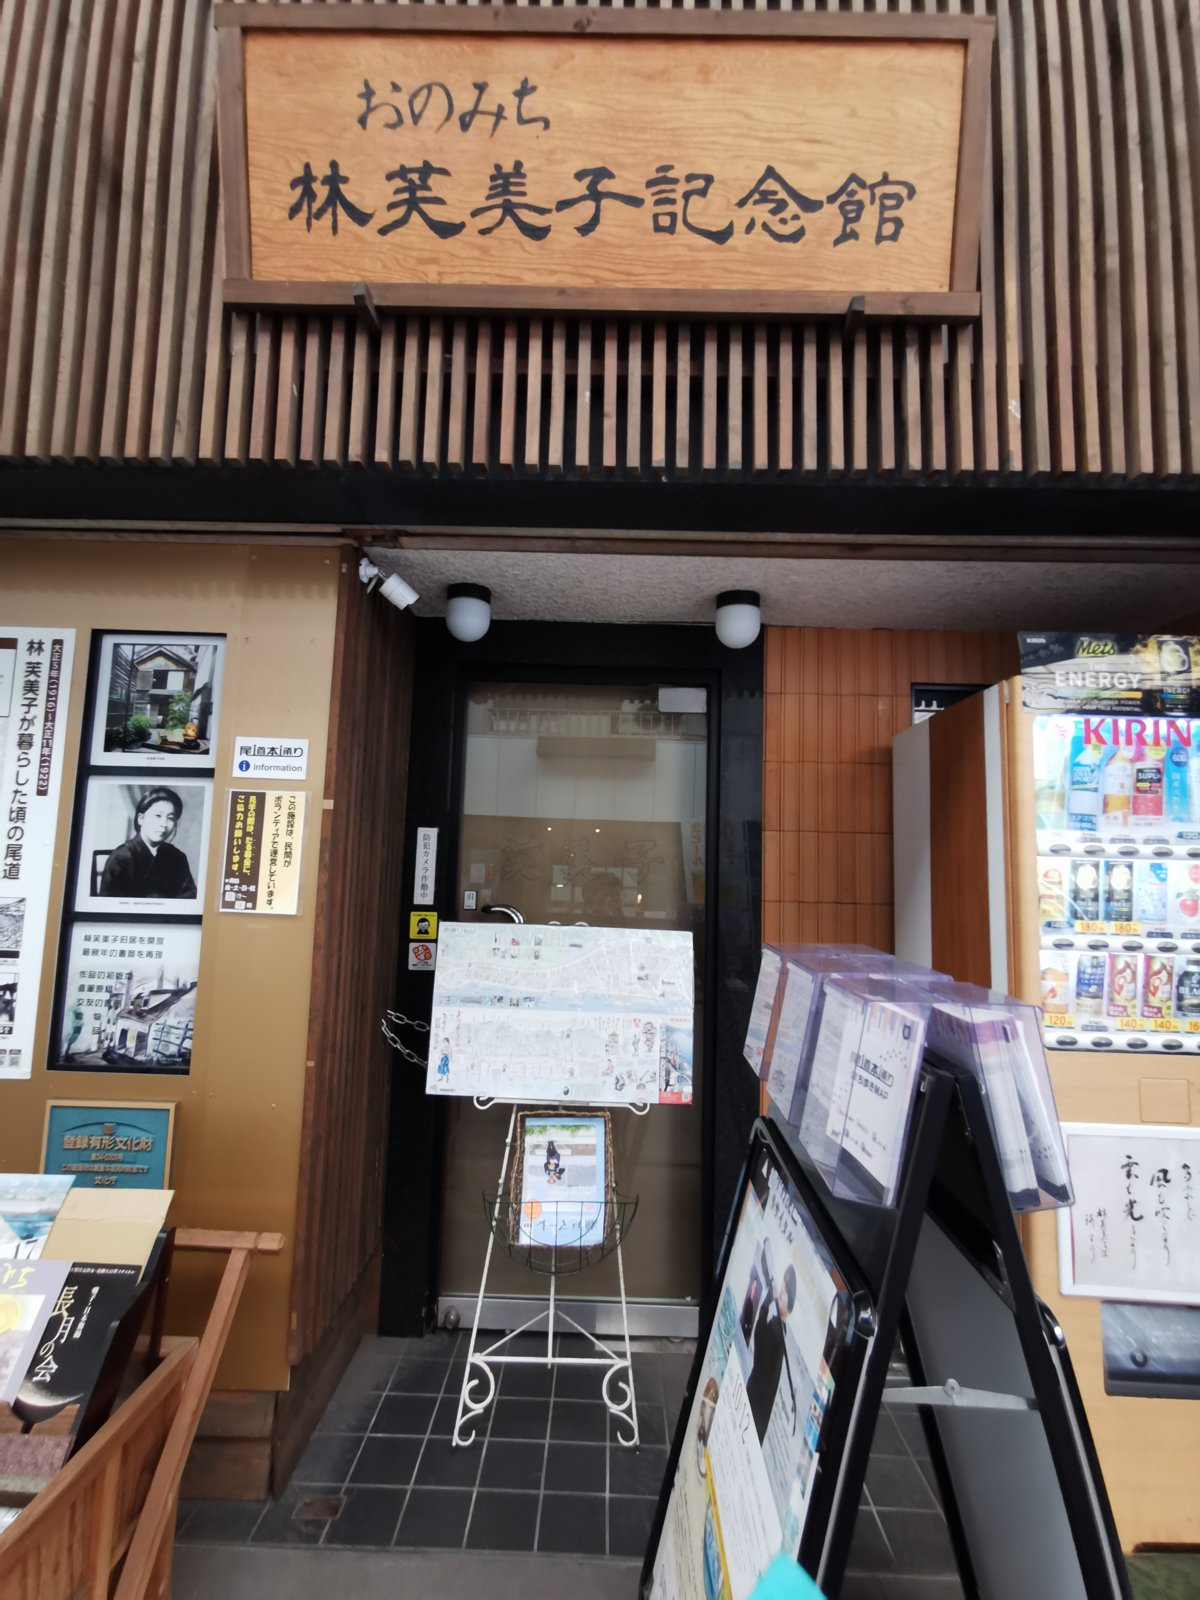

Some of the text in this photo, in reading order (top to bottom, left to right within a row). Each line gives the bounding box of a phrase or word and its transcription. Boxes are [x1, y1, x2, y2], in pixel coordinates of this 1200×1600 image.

[356, 77, 550, 137] おのみち
[288, 160, 916, 247] 林芙美子記念館
[1076, 639, 1116, 656] Mets
[1055, 671, 1142, 689] ENERGY
[1083, 718, 1192, 747] KIRIN
[240, 744, 304, 758] 尾道本通り
[253, 763, 302, 773] information
[420, 833, 431, 900] 防犯カメラ作動中
[63, 1135, 155, 1152] 登録有形文化財
[32, 1285, 78, 1383] 長月の会
